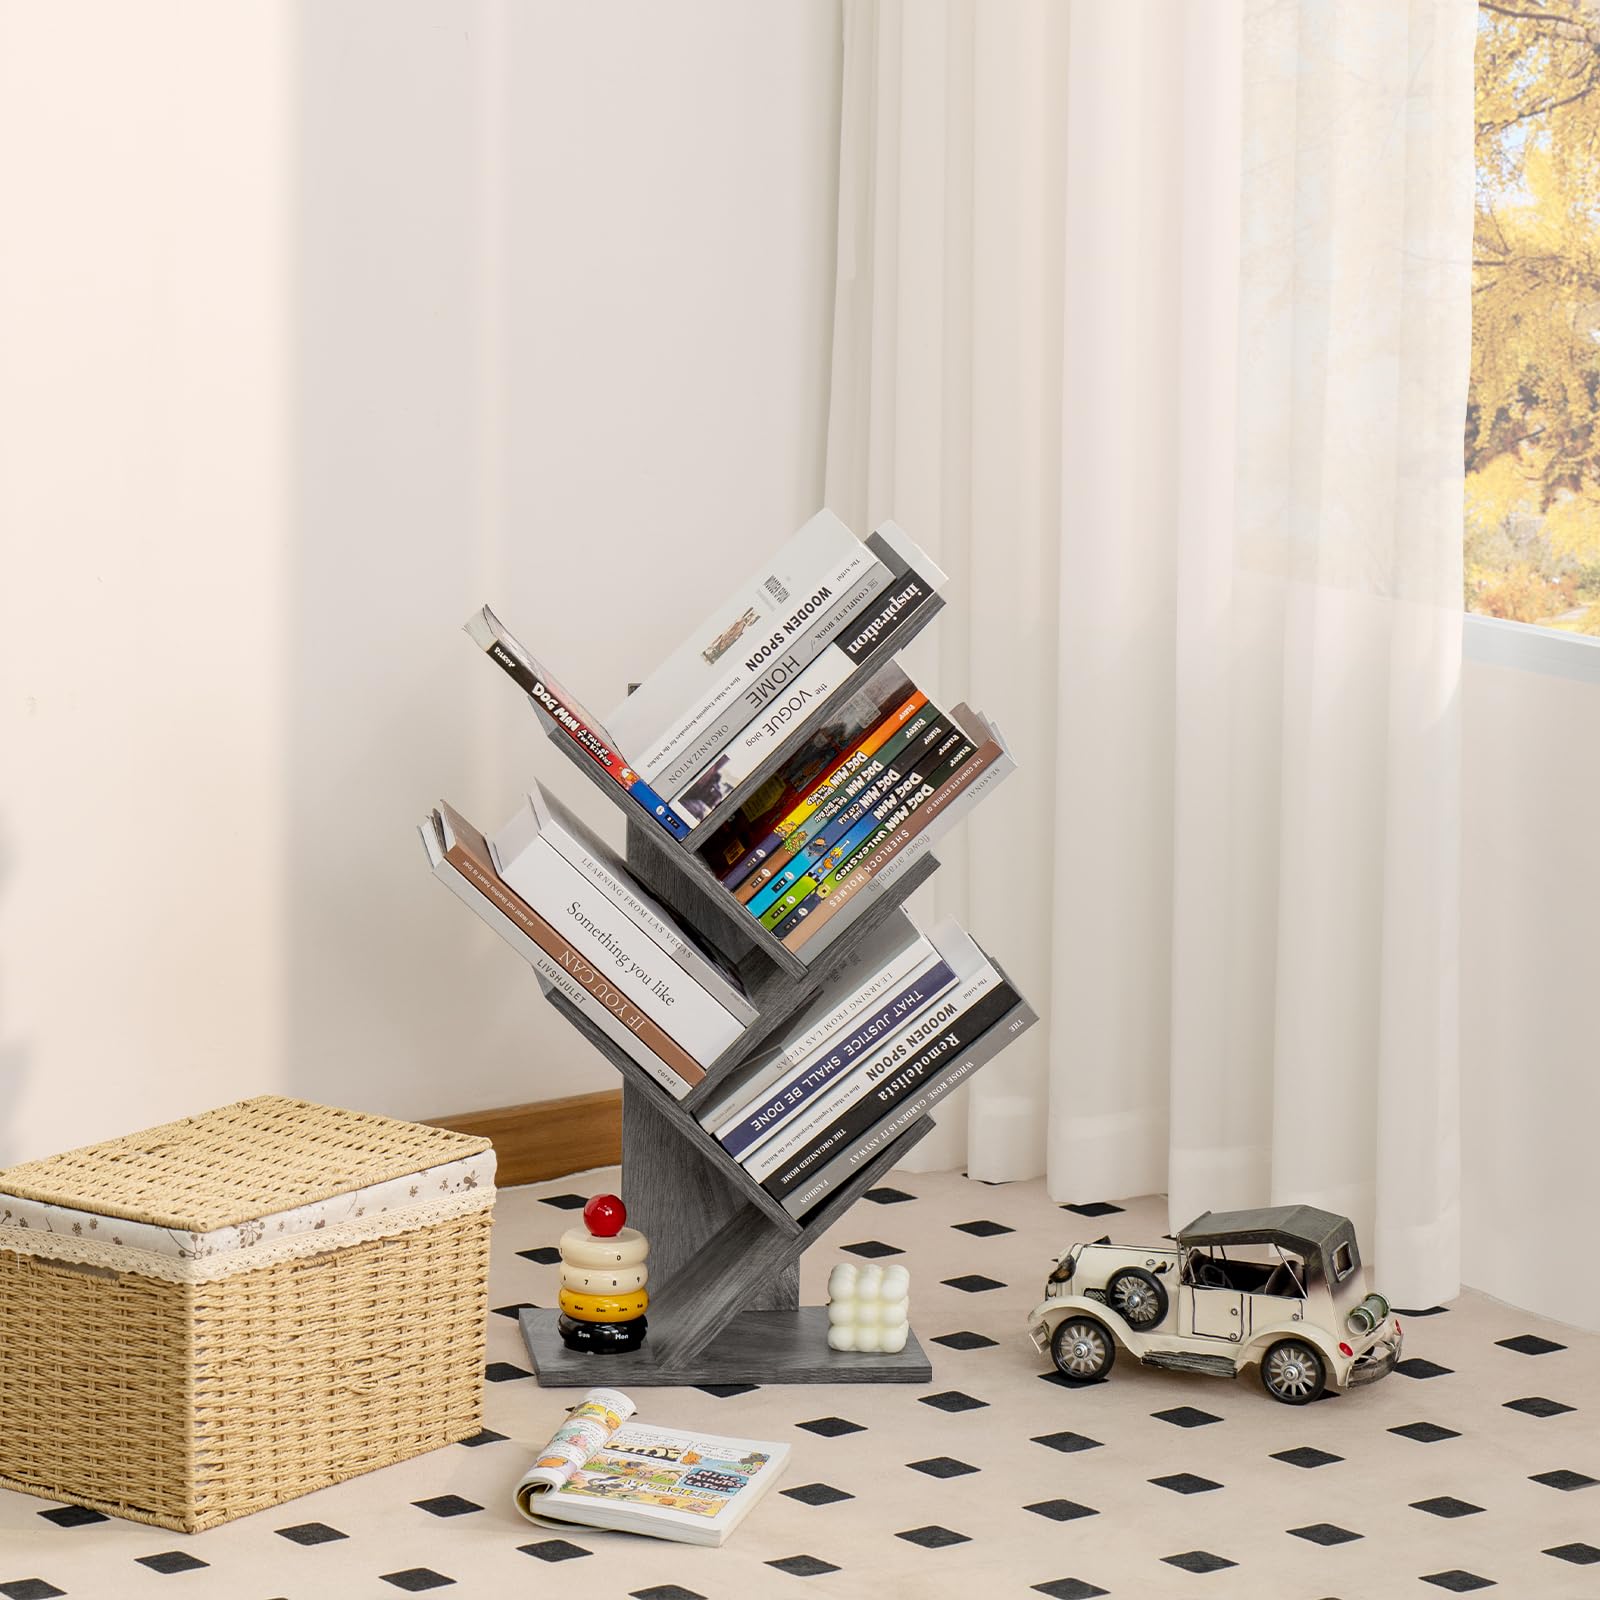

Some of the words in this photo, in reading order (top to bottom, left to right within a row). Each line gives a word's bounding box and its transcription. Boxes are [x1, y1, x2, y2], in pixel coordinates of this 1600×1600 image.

[781, 586, 832, 635] WOODEN
[833, 587, 869, 622] COMPLETE
[845, 581, 922, 655] inspiration
[814, 620, 835, 640] BOOK
[744, 631, 785, 672] SPOON
[745, 655, 800, 709] HOME
[814, 682, 828, 695] the
[762, 688, 812, 736] VOGUE
[745, 730, 763, 747] blog
[668, 724, 729, 784] ORGANIZATION
[972, 758, 983, 768] THE
[949, 766, 974, 790] COMPLETE
[967, 767, 1000, 799] SEASONAL
[925, 806, 933, 814] OF
[931, 788, 951, 808] STORIES
[863, 829, 909, 874] SHERLOCK
[905, 833, 930, 857] flower
[477, 874, 491, 888] heart
[865, 855, 905, 894] arranging
[829, 873, 865, 908] HOLMES
[506, 901, 516, 911] not
[581, 857, 624, 897] LEARNING
[623, 895, 647, 918] FROM
[647, 917, 665, 934] LAS
[665, 932, 693, 959] VEGAS
[558, 949, 597, 984] CAN
[564, 901, 633, 967] Something
[624, 961, 652, 986] you
[650, 979, 677, 1007] like
[536, 959, 586, 1004] LIVSHJULET
[848, 972, 893, 1010] LEARNING
[592, 982, 628, 1017] YOU
[891, 989, 924, 1017] THAT
[626, 1013, 645, 1031] IF
[823, 1009, 848, 1031] FROM
[842, 1012, 892, 1056] JUSTICE
[905, 1002, 958, 1048] WOODEN
[1008, 1018, 1024, 1032] THE
[805, 1030, 823, 1046] LAS
[775, 1045, 805, 1071] VEGAS
[801, 1055, 841, 1088] SHALL
[865, 1044, 907, 1081] SPOON
[876, 1032, 961, 1102] Remodelista
[946, 1060, 974, 1084] WHOSE
[657, 1068, 677, 1087] corset
[927, 1081, 948, 1100] ROSE
[784, 1086, 803, 1104] BE
[750, 1100, 785, 1131] DONE
[896, 1098, 927, 1125] GARDEN
[832, 1128, 846, 1141] THE
[879, 1129, 889, 1139] IT
[887, 1122, 897, 1132] IS
[798, 1138, 834, 1169] ORGANIZED
[848, 1137, 880, 1165] ANYWAY
[780, 1166, 800, 1184] HOME
[799, 1179, 829, 1204] FASHION
